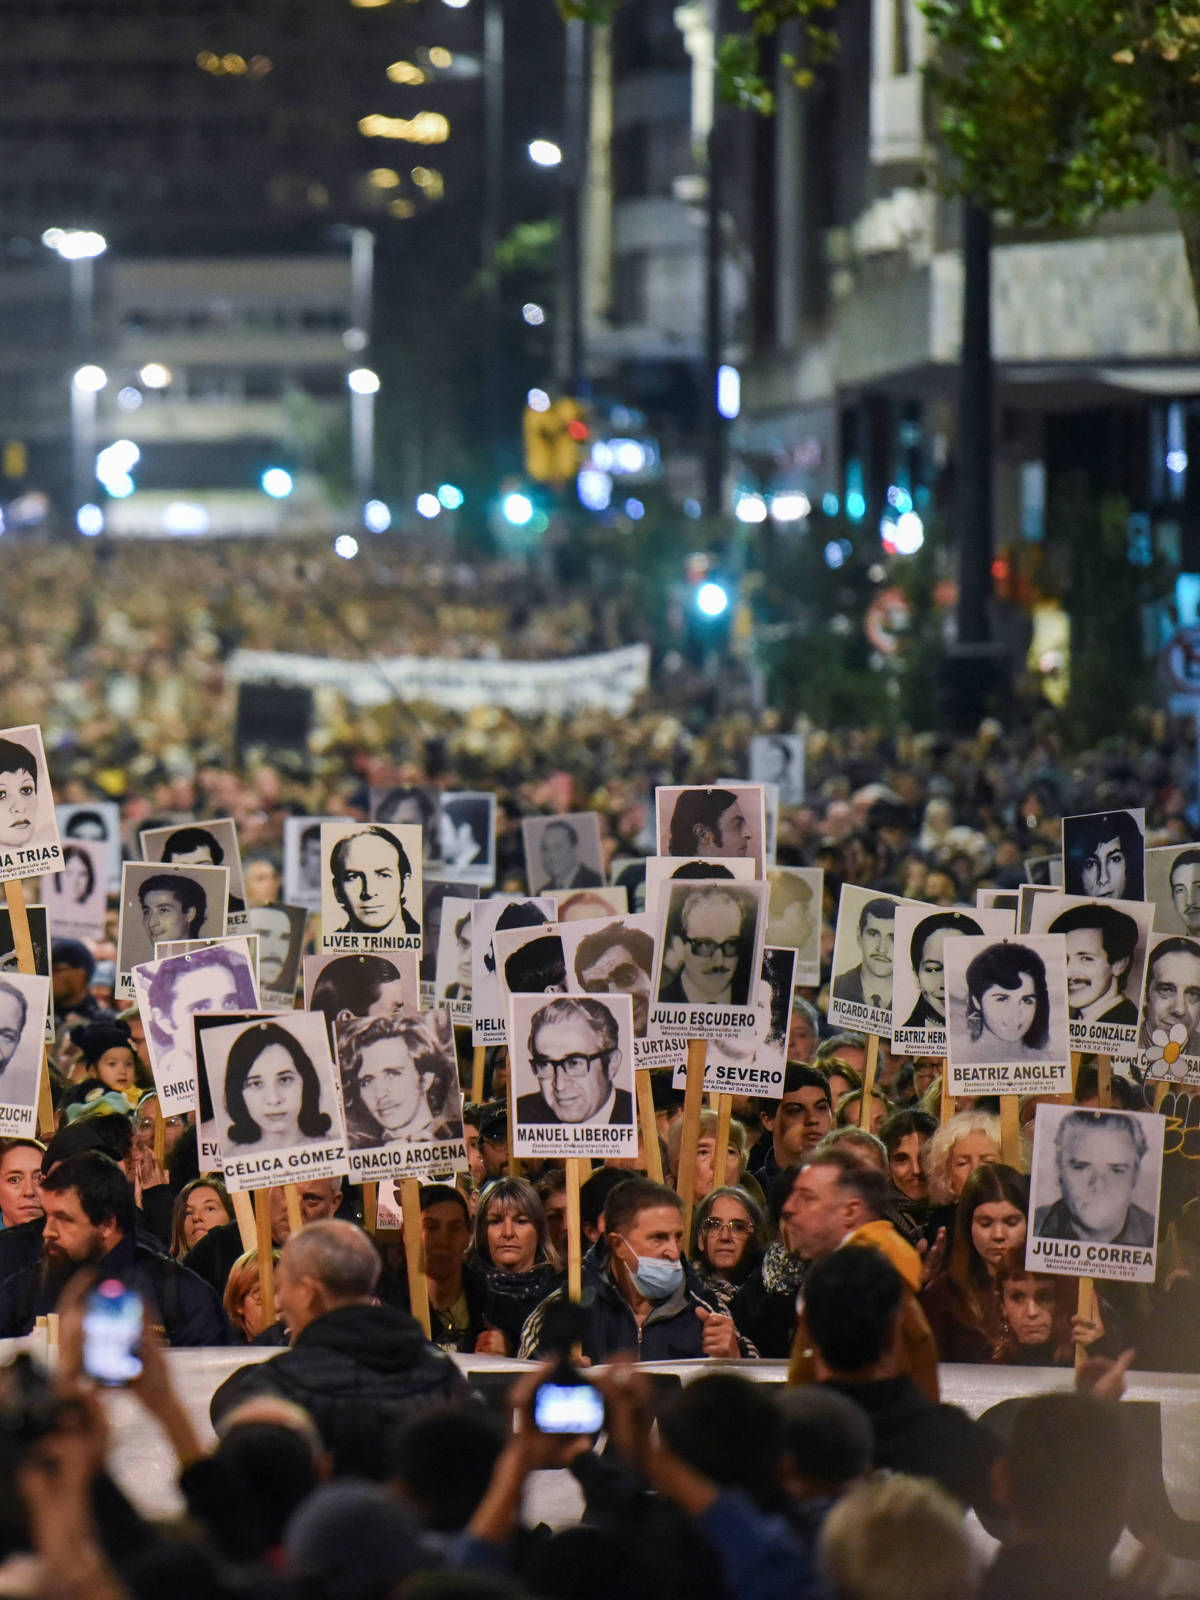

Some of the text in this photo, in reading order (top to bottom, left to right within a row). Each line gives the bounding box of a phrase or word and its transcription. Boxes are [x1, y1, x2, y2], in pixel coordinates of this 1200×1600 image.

[17, 845, 60, 863] TRIAS
[323, 936, 422, 949] LIVER TRINIDAD
[121, 976, 136, 987] M
[833, 1000, 869, 1019] RICARDO
[650, 1010, 755, 1027] JULIO ESCUDERO
[895, 1030, 926, 1043] BEATRIZ
[1090, 1025, 1137, 1043] GONZÁLEZ
[716, 1065, 783, 1084] SEVERO
[953, 1066, 1066, 1081] BEATRIZ ANGLET
[517, 1128, 634, 1141] MANUEL LIBEROFF
[202, 1143, 221, 1156] EV
[349, 1144, 467, 1170] IGNACIO AROCENA
[225, 1147, 346, 1177] CÉLICA GÓMEZ
[1032, 1241, 1154, 1266] JULIO CORREA
